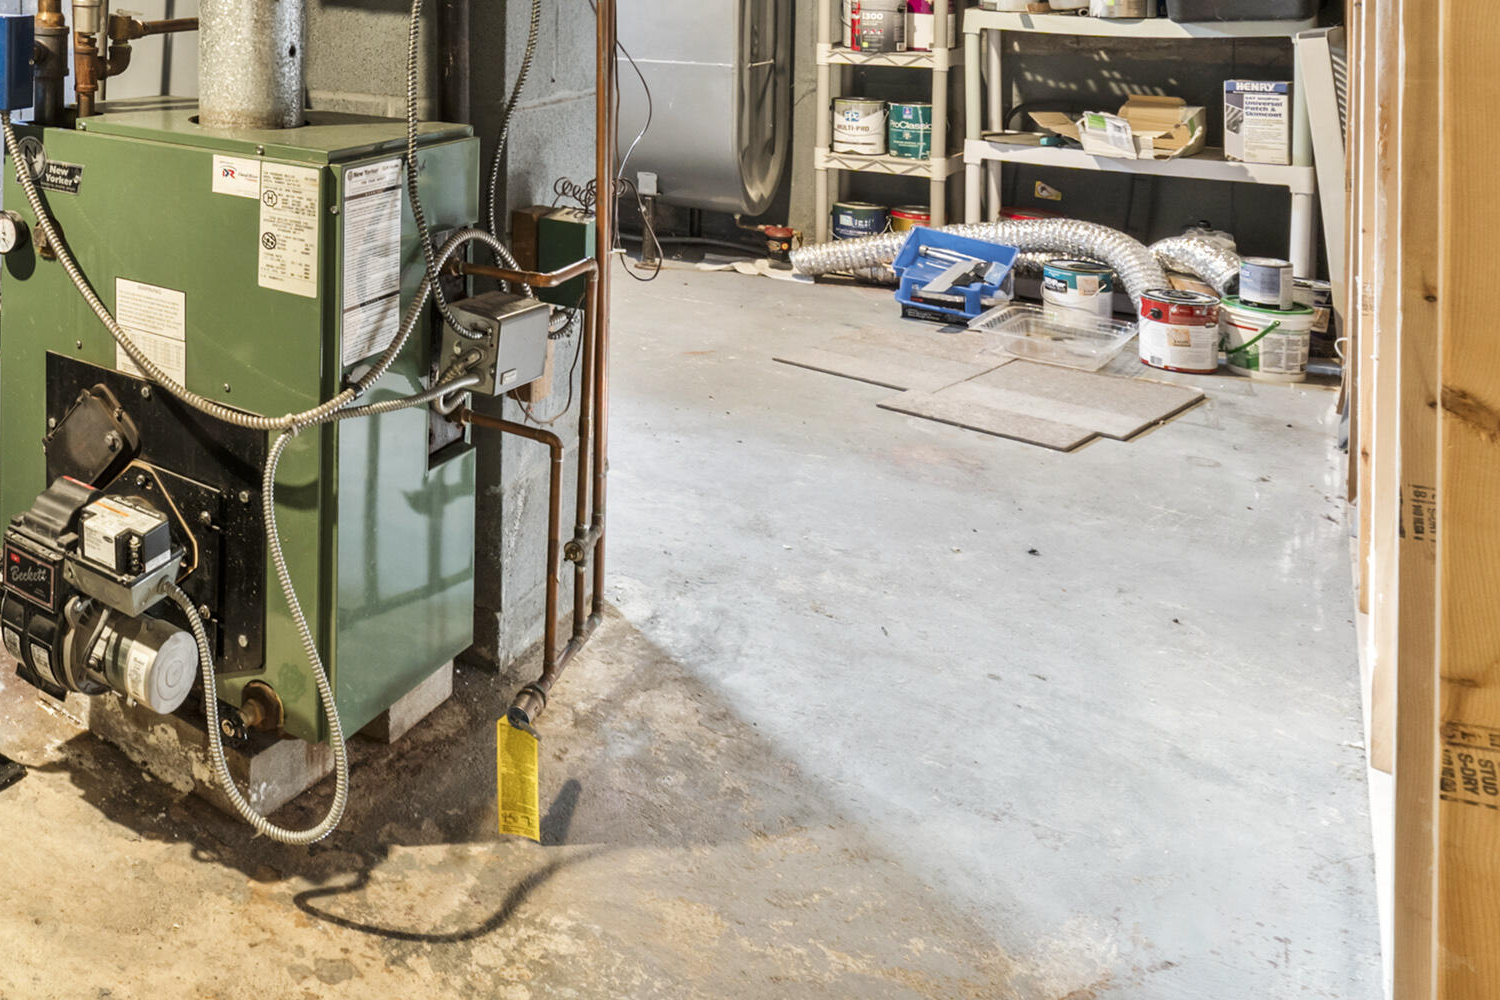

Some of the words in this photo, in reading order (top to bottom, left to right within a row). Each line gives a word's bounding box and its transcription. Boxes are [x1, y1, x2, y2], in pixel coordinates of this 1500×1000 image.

[1236, 82, 1275, 91] HENRY
[49, 165, 69, 176] New
[45, 173, 73, 186] Yorker
[10, 565, 47, 582] Beckett
[1457, 752, 1480, 796] S-DRY
[1478, 758, 1499, 797] STUD
